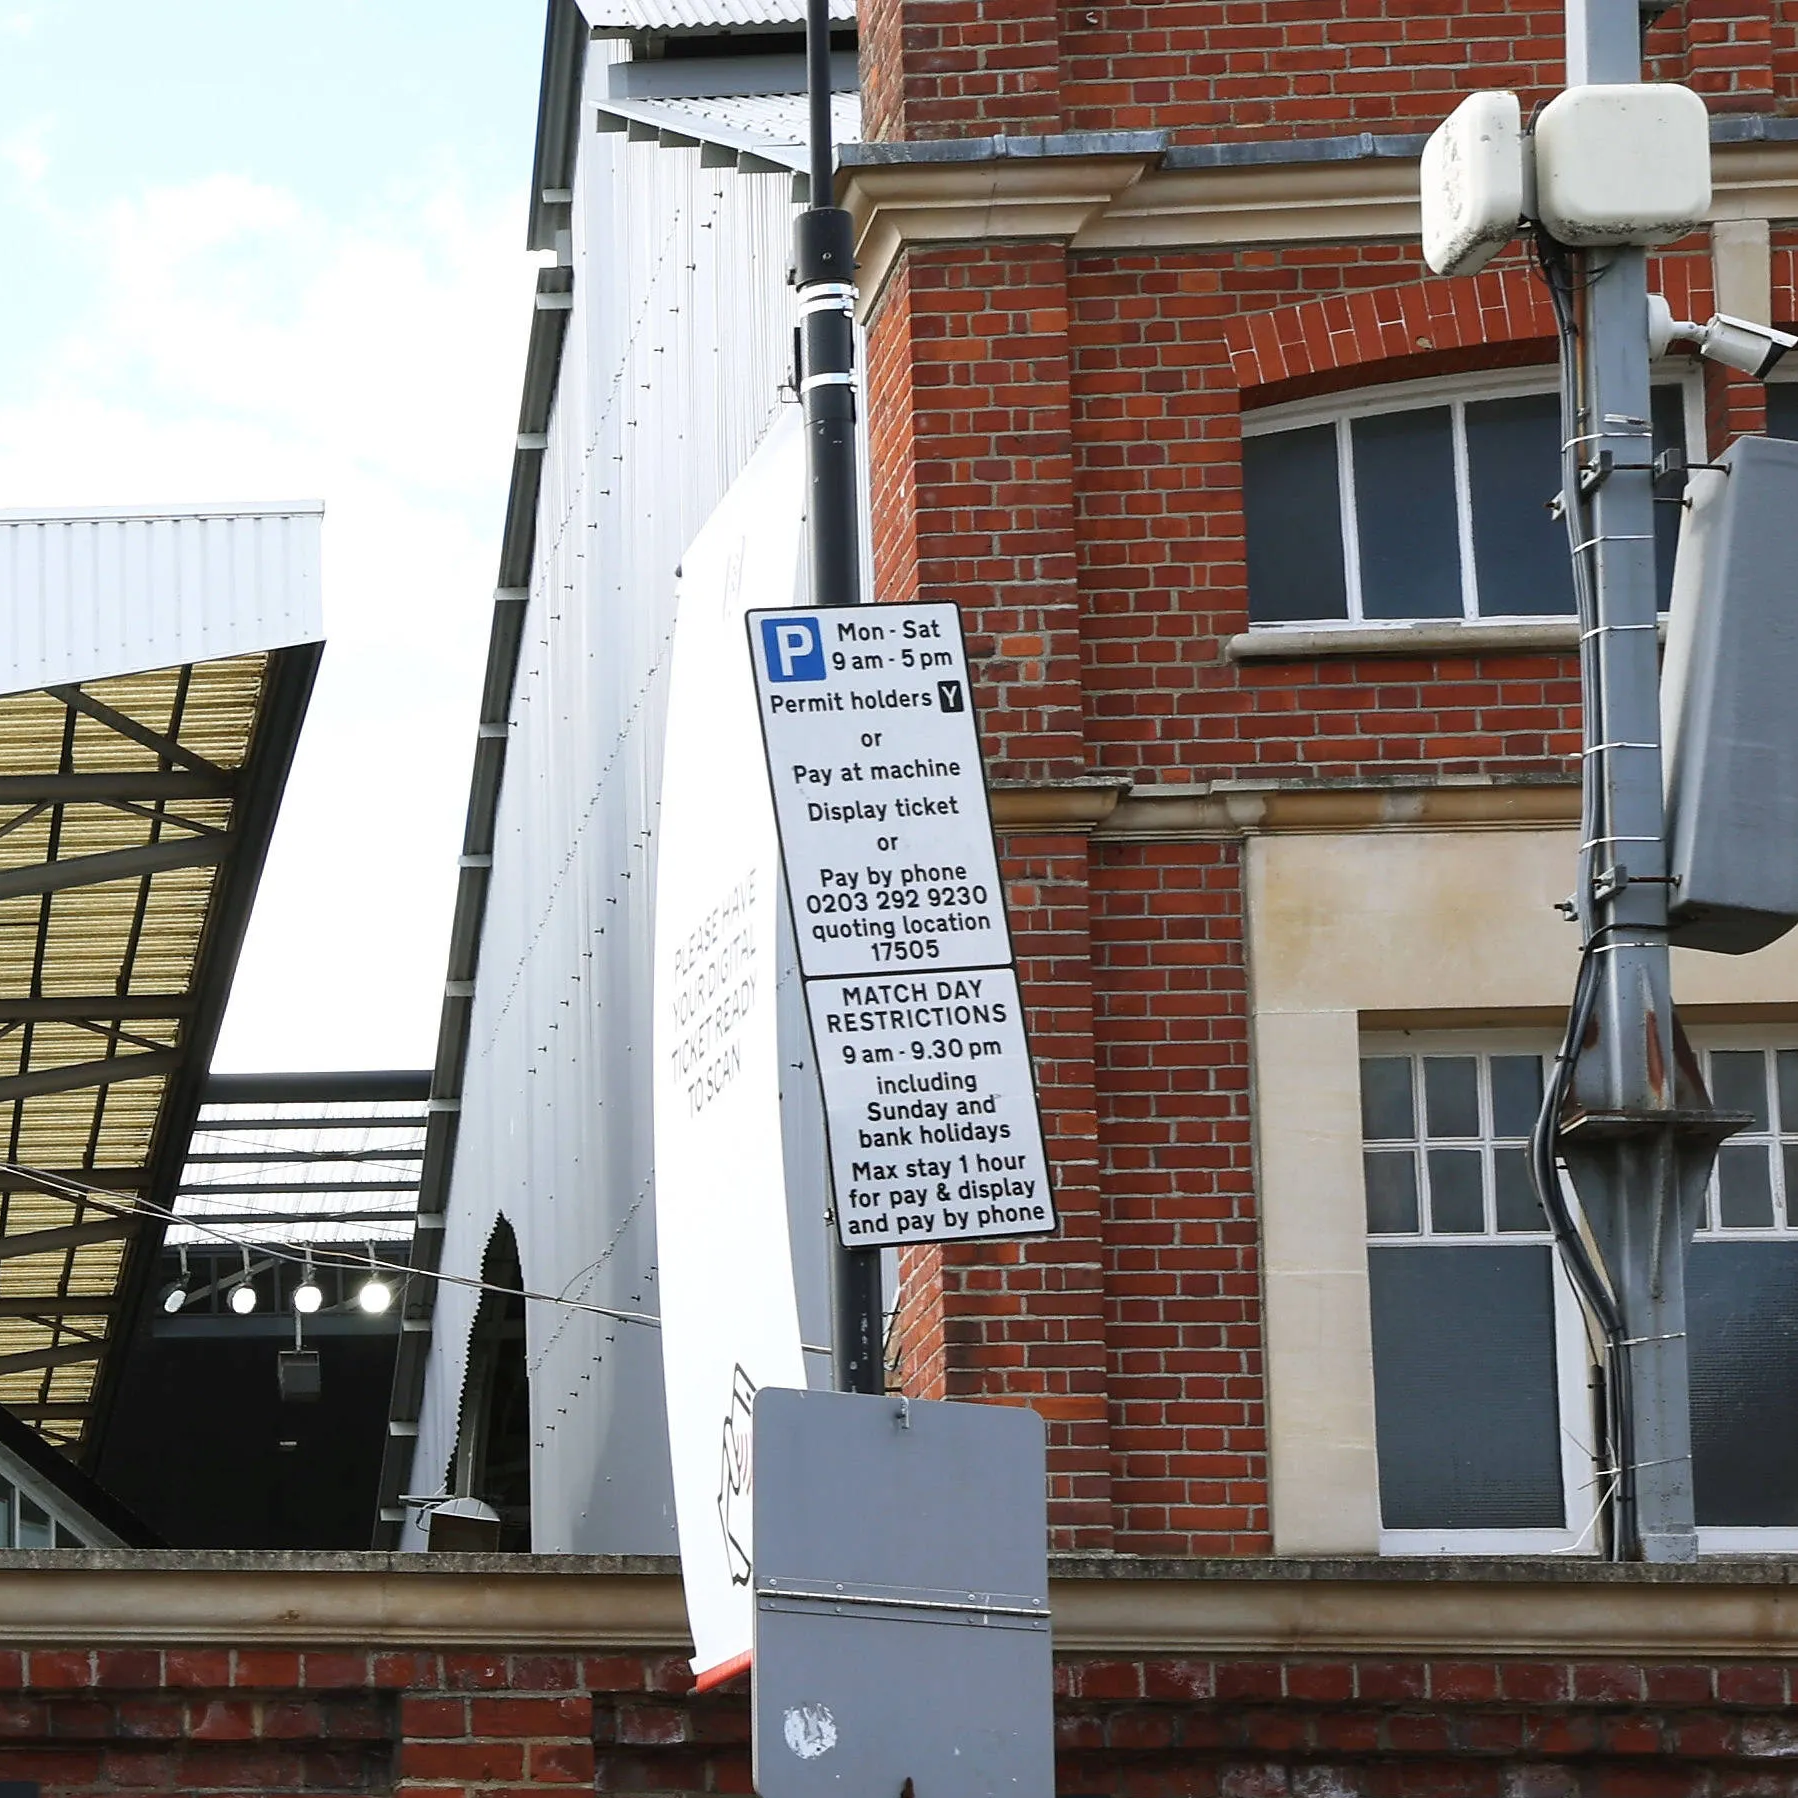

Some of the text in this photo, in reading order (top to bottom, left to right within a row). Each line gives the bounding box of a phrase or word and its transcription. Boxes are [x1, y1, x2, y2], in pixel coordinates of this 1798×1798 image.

[837, 623, 884, 641] Mon
[903, 620, 941, 639] Sat
[776, 625, 814, 677] P
[832, 652, 846, 670] 9
[852, 656, 884, 669] am
[901, 649, 915, 668] 5
[921, 651, 953, 670] pm
[770, 685, 958, 713] Permit holders Y
[861, 732, 882, 747] or
[793, 758, 961, 786] Pay at machine
[807, 796, 960, 823] Display ticket
[877, 836, 899, 851] or
[820, 863, 967, 890] Pay by phone
[806, 885, 988, 914] 0203 292 9230
[675, 868, 756, 984] PLEASE HAVE
[812, 912, 991, 942] quoting location
[871, 940, 940, 961] 17505
[672, 923, 757, 1033] YOUR DIGITAL
[842, 979, 982, 1006] MATCH DAY
[672, 968, 757, 1084] TICKET READY
[826, 1003, 1007, 1033] RESTRICTIONS
[842, 1045, 856, 1064] 9
[863, 1049, 894, 1064] am
[911, 1038, 963, 1060] 9.30
[970, 1040, 1002, 1059] pm
[688, 1038, 741, 1119] TO SCAN
[877, 1071, 978, 1095] including
[867, 1095, 996, 1122] Sunday and
[859, 1122, 1011, 1148] bank holidays
[852, 1153, 1026, 1182] Max stay 1 hour
[849, 1177, 1035, 1209] for pay & display
[848, 1204, 1045, 1235] and pay by phone
